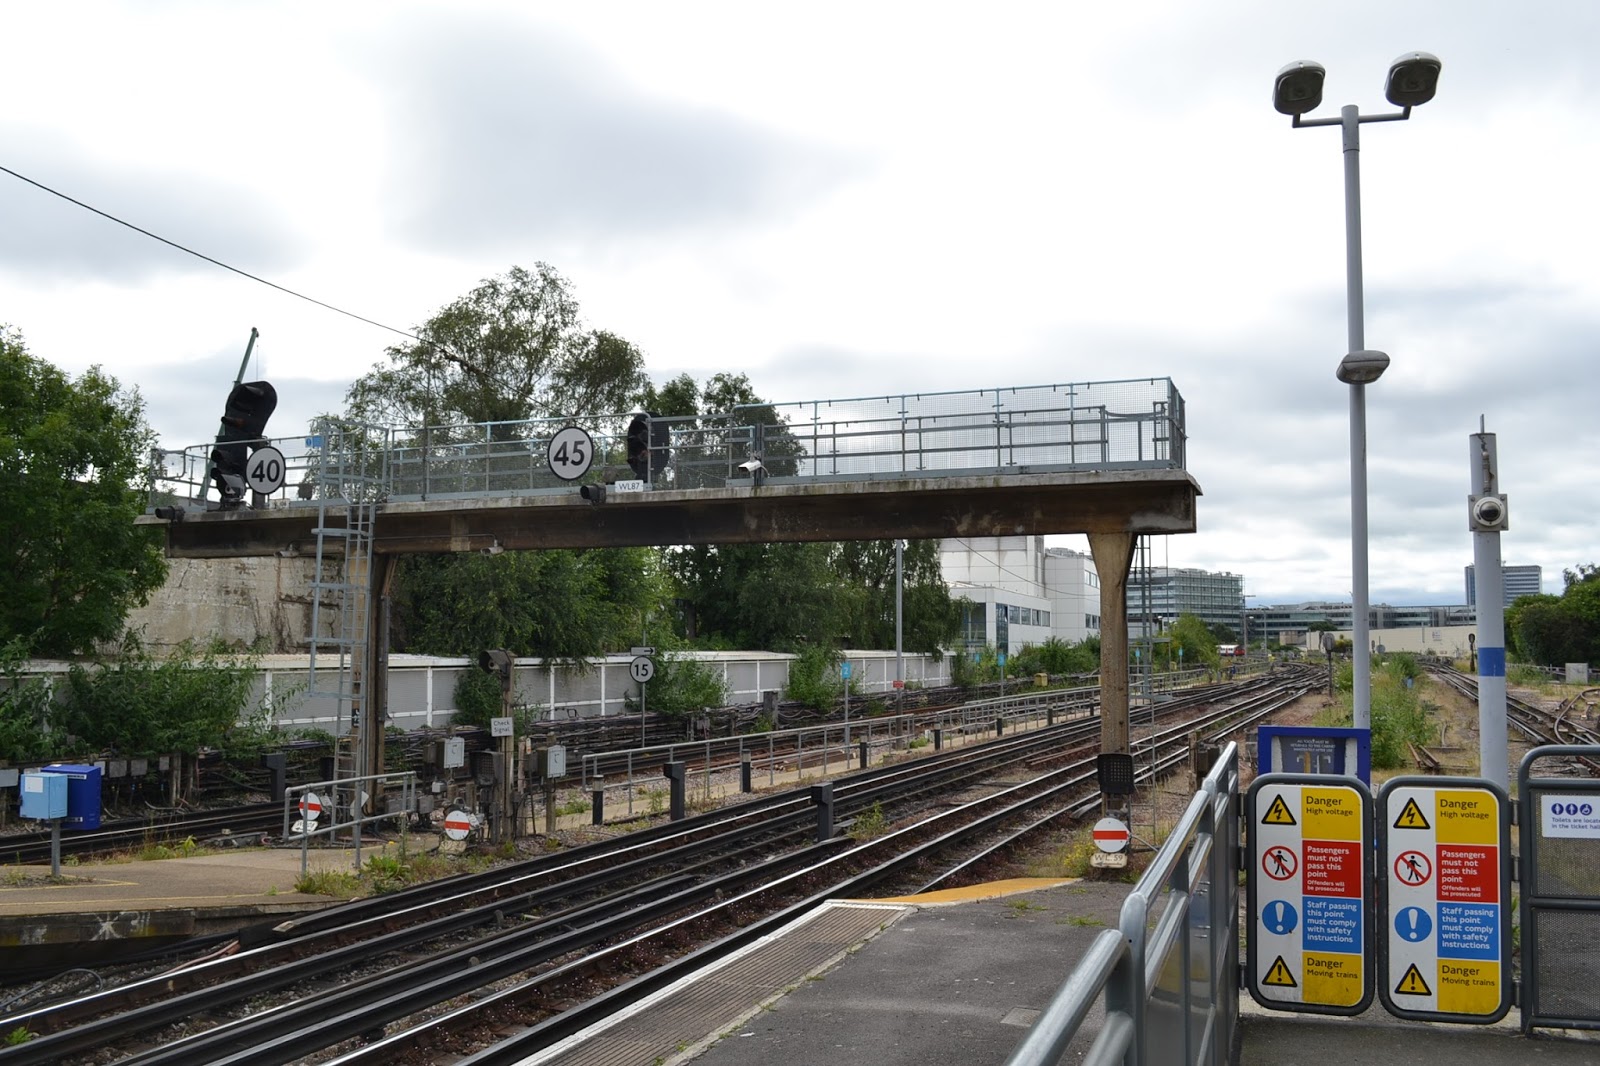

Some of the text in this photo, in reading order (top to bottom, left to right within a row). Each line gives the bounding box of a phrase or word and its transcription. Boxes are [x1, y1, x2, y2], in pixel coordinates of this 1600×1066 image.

[553, 440, 586, 466] 45
[251, 459, 280, 483] 40
[618, 482, 640, 490] WL87
[634, 663, 649, 677] 15
[843, 667, 849, 675] 2
[1306, 796, 1342, 807] Danger
[1440, 799, 1478, 810] Danger
[1306, 808, 1353, 816] High voltage
[1440, 811, 1489, 820] High voltage
[1307, 846, 1350, 856] Passengers
[1442, 850, 1486, 860] Passengers
[1327, 863, 1341, 871] this
[1307, 901, 1357, 912] Staff passing
[1464, 909, 1494, 917] passing
[1329, 920, 1356, 928] comply
[1327, 927, 1352, 936] safety
[1465, 926, 1493, 934] comply
[1307, 934, 1353, 943] instructions
[1462, 933, 1488, 942] safety
[1442, 940, 1490, 949] instructions
[1307, 958, 1343, 969] Danger
[1307, 970, 1334, 978] Moving
[1442, 965, 1480, 977] Danger
[1442, 977, 1470, 986] Moving
